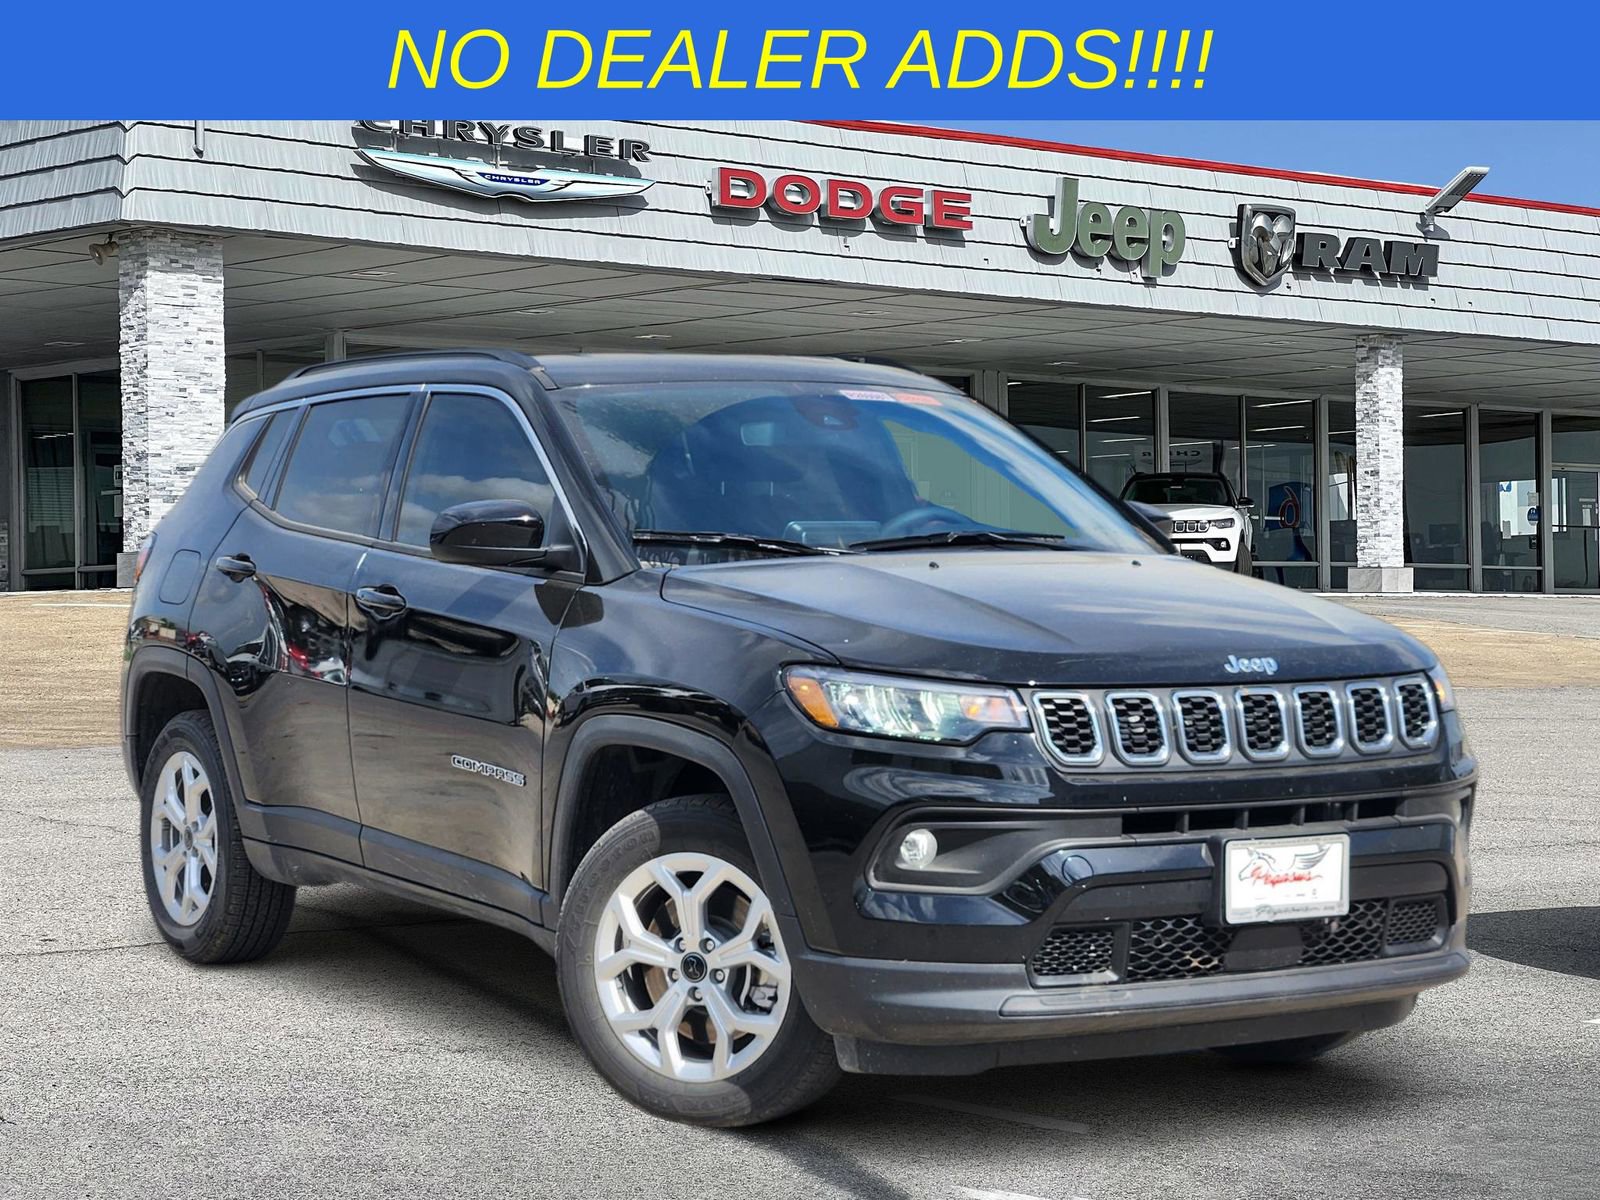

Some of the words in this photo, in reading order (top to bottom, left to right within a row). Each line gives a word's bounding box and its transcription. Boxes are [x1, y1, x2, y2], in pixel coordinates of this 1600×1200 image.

[484, 174, 541, 185] CHRYSLER
[711, 167, 973, 230] DODGE
[1026, 177, 1186, 278] Jeep
[1298, 232, 1440, 278] RAM
[1224, 655, 1279, 675] Jeep
[451, 755, 527, 786] COMPASS
